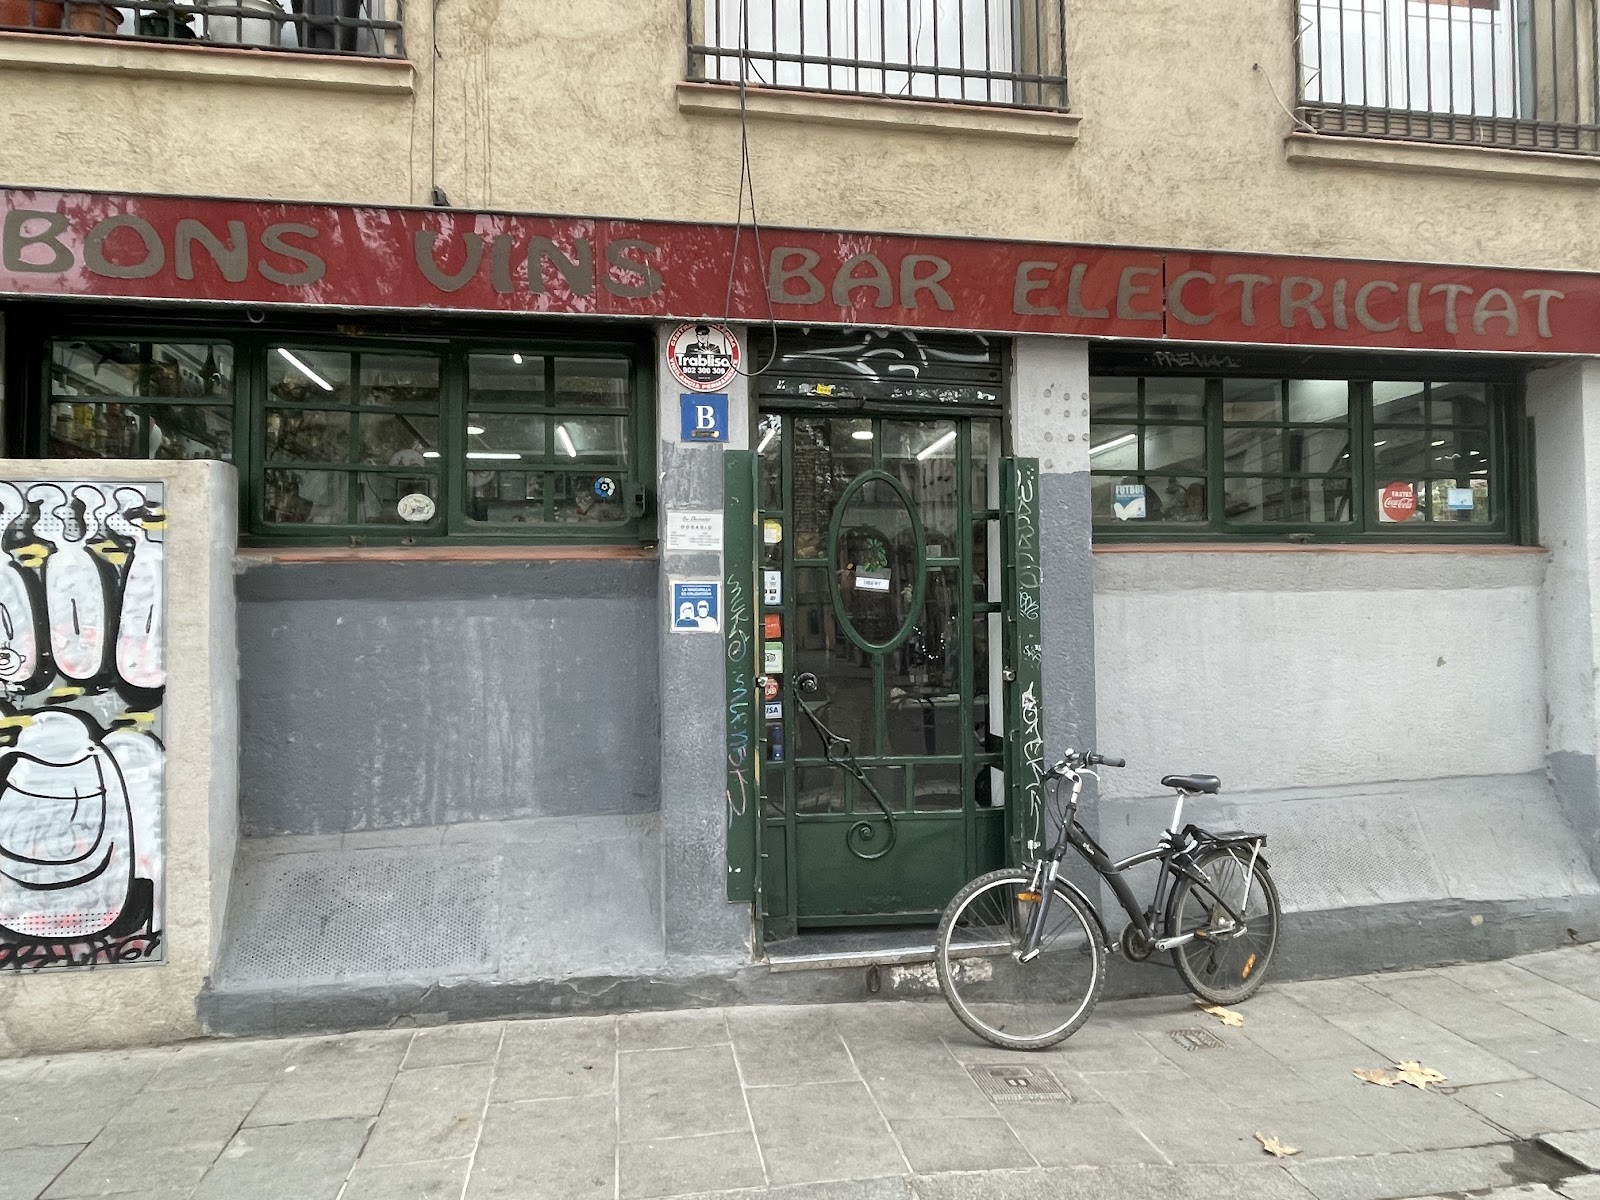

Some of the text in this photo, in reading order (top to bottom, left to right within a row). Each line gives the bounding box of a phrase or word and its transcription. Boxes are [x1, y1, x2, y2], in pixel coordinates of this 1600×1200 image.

[3, 210, 326, 285] BONS
[768, 246, 955, 312] BAR
[1013, 260, 1566, 338] ELECTRICITAT
[676, 353, 730, 367] Trablisa
[712, 367, 726, 375] 309
[669, 358, 700, 389] VIGILANCIA
[695, 405, 716, 429] B
